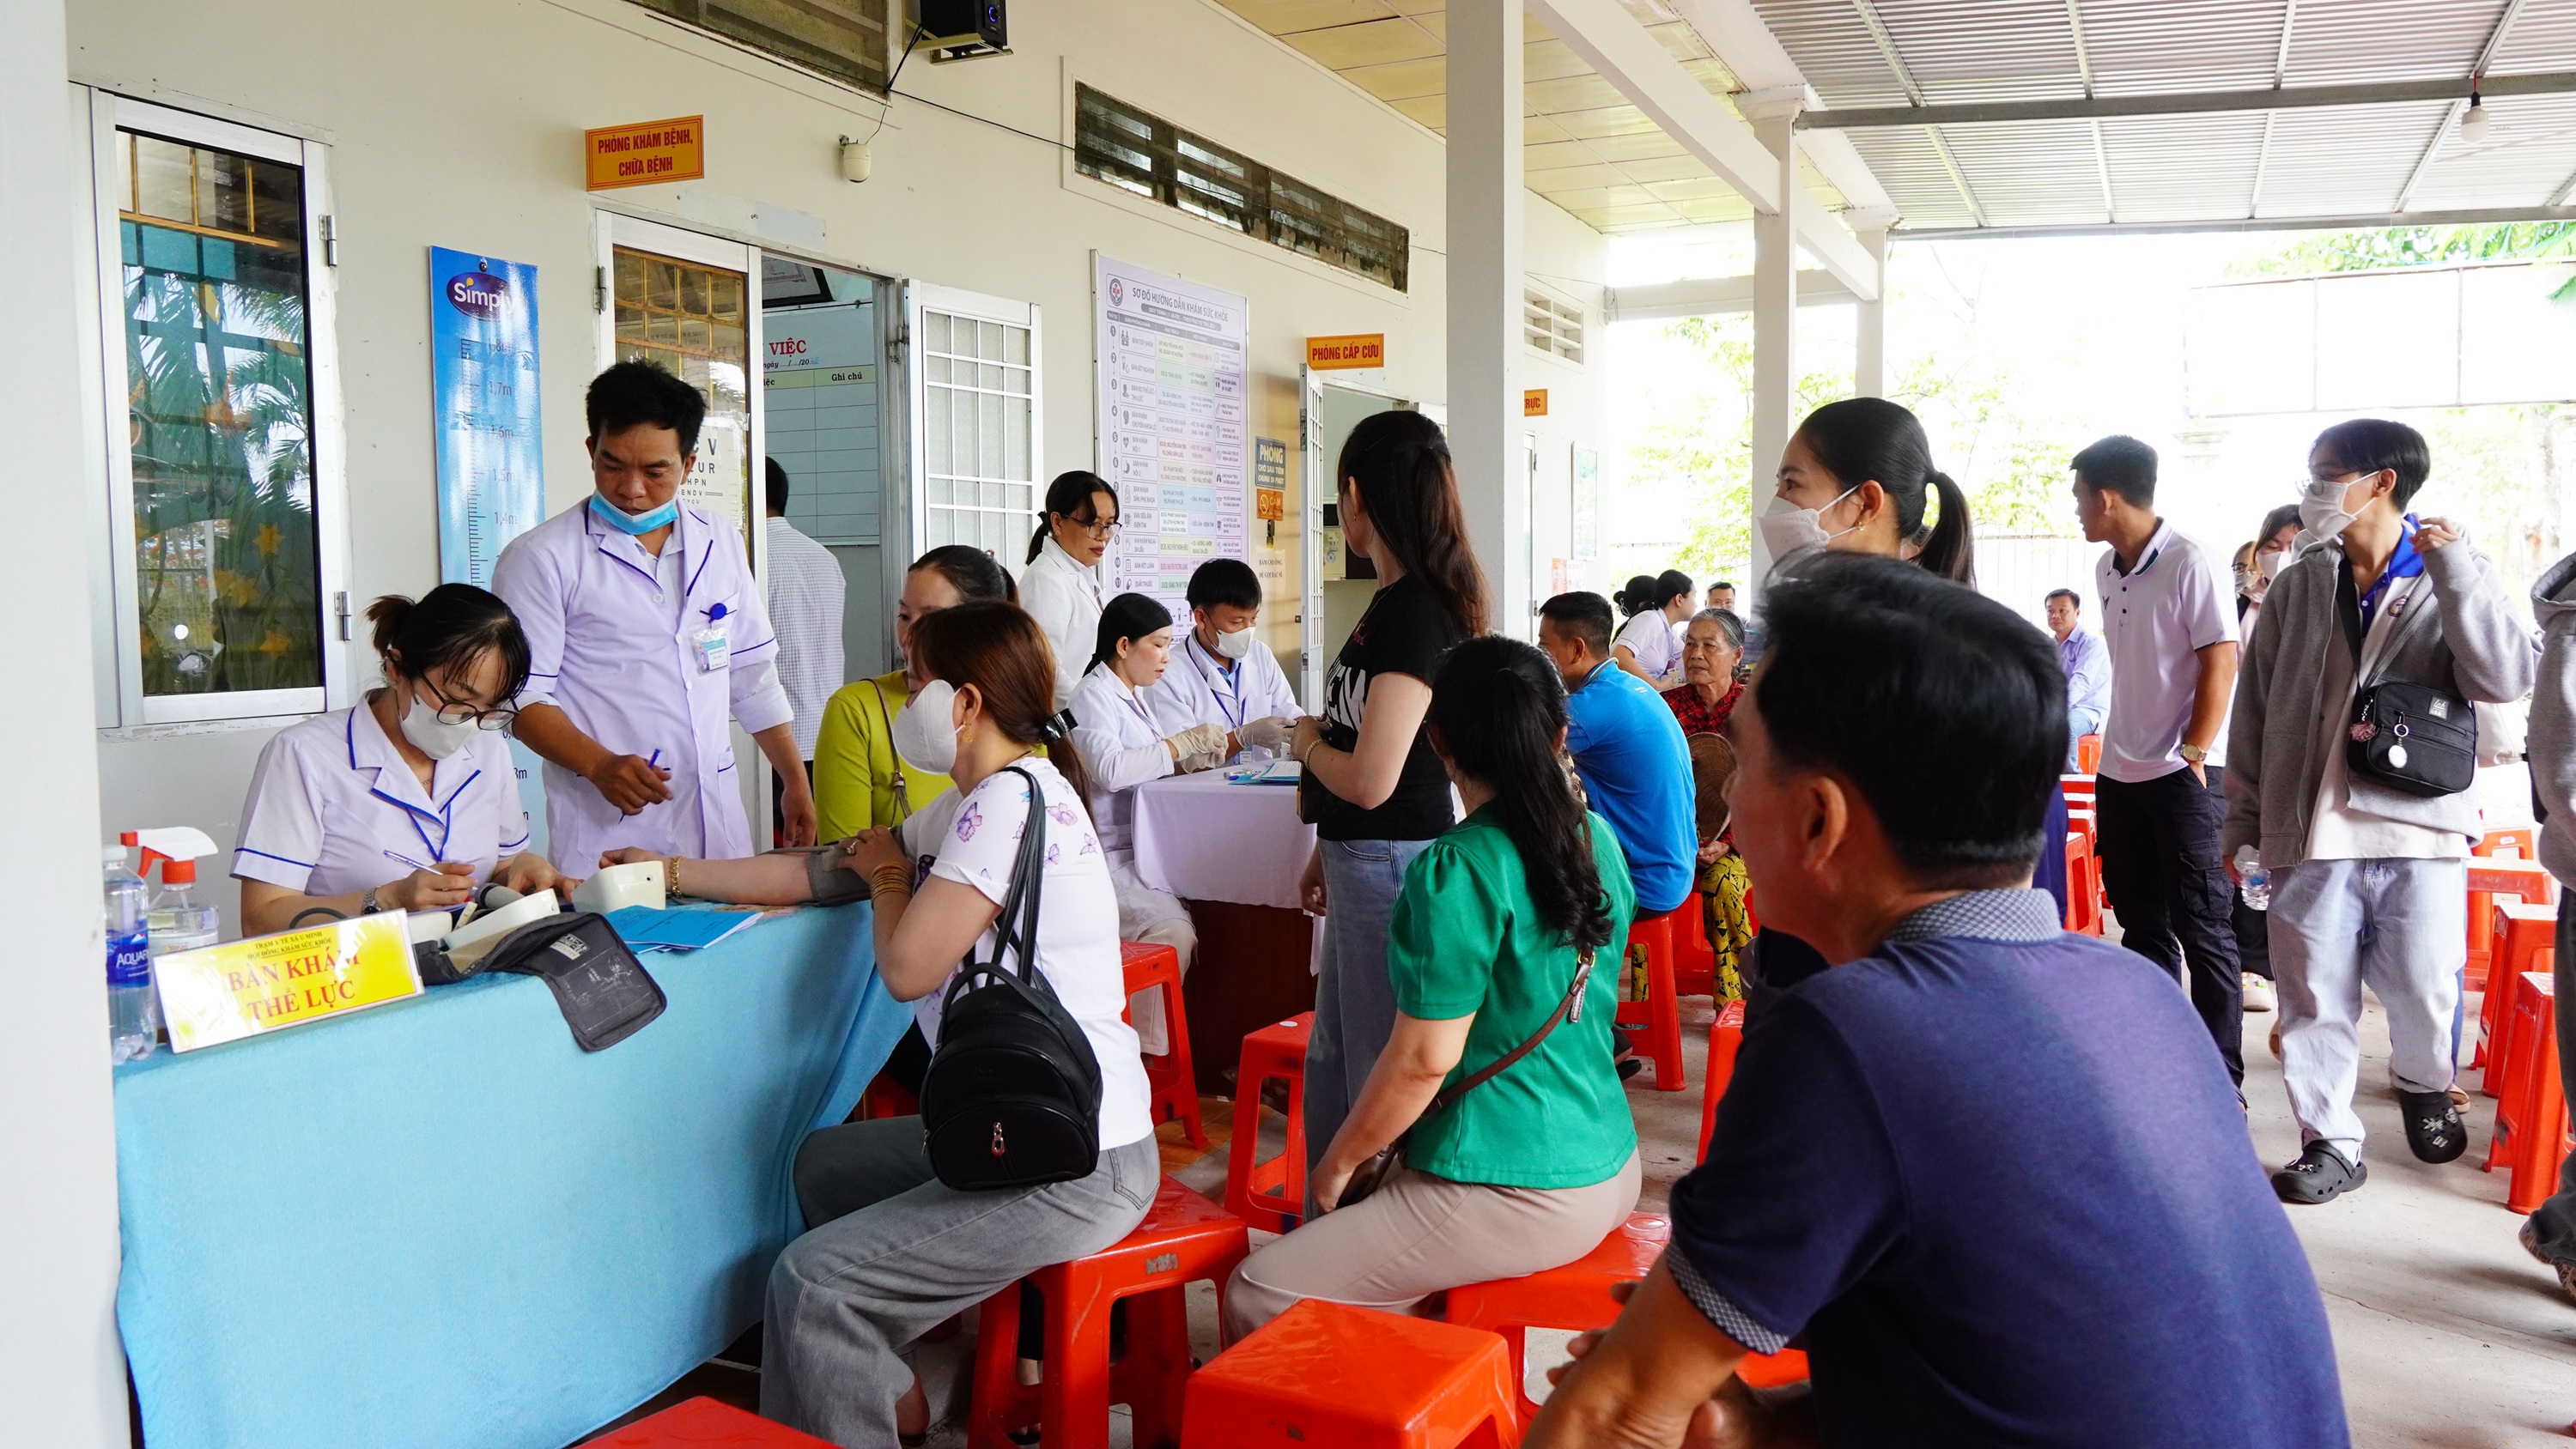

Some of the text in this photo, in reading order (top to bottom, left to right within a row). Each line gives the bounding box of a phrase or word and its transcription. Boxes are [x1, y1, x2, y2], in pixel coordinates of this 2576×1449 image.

[598, 128, 693, 154] PHÒNG KHÁM BỆNH,
[618, 155, 673, 177] CHỮA BỆNH
[769, 336, 807, 358] VIỆC
[1312, 341, 1379, 361] PHÒNG CẤP CỨU
[763, 360, 779, 369] ngày
[763, 379, 775, 387] iệc
[831, 372, 863, 381] Ghi chú
[489, 381, 513, 397] 1,7m
[1260, 443, 1284, 464] PHÒNG
[255, 940, 273, 949] TRẠM
[280, 936, 289, 945] TẾ
[289, 934, 299, 943] XÃ
[305, 931, 323, 940] MINH
[261, 947, 280, 957] ĐỒNG
[281, 943, 301, 953] KHÁM
[301, 940, 313, 949] SỨC
[314, 937, 332, 948] KHỎE
[228, 962, 280, 992] BÀN
[246, 979, 355, 1021] THỂ LỰC
